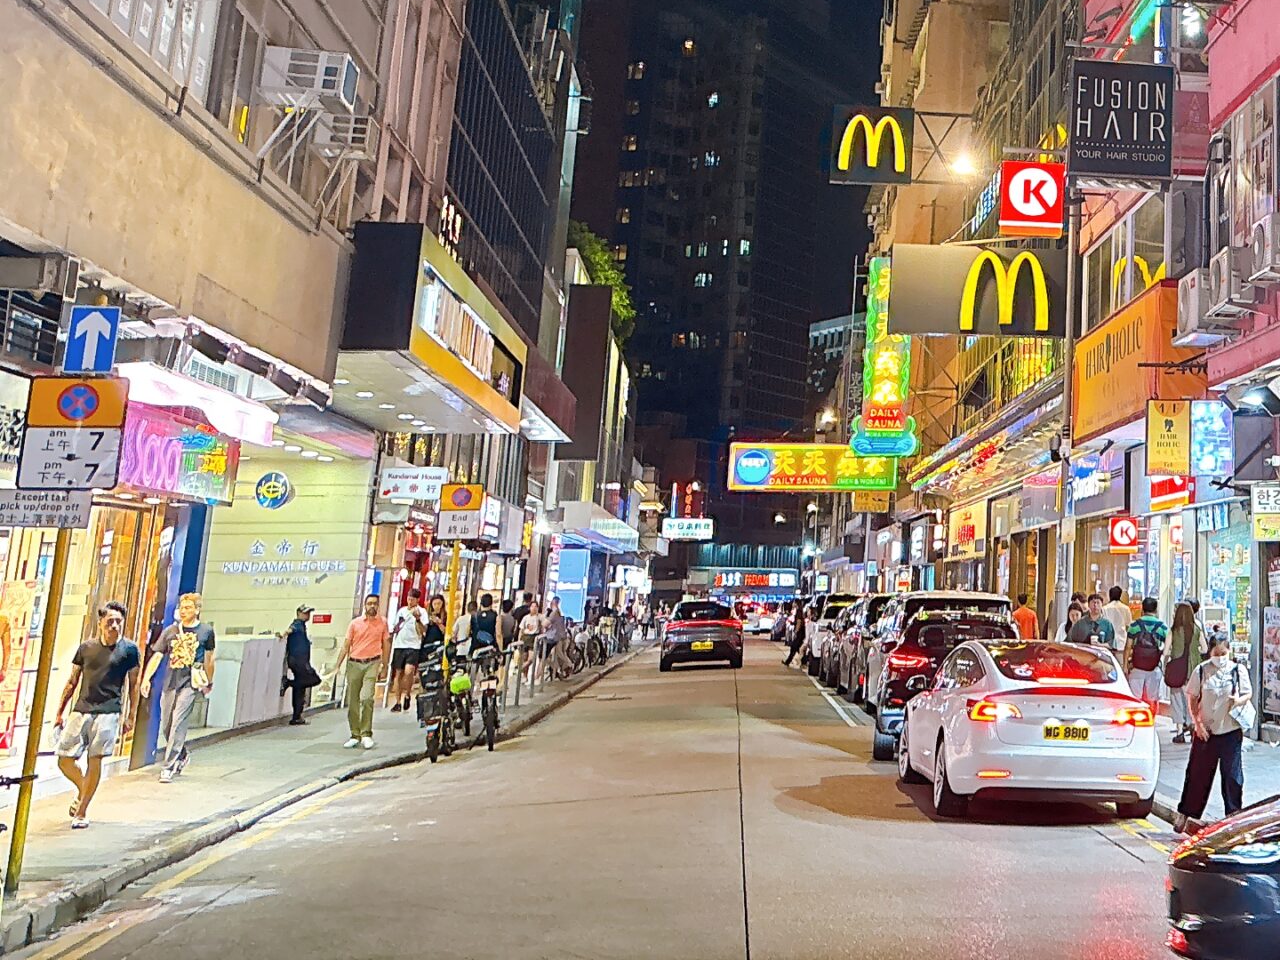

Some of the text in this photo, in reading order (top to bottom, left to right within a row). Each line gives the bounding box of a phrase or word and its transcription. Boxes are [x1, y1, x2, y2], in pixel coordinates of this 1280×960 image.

[1077, 76, 1166, 111] FUSION
[1076, 107, 1166, 142] HAIR
[1076, 149, 1166, 162] YOUR HAIR STUDIO
[1085, 316, 1143, 381] HAIR HOLIC
[870, 408, 899, 418] DAILY
[867, 419, 901, 428] SAUNA
[41, 439, 71, 451] 上午
[89, 431, 105, 451] 7
[38, 471, 66, 483] 下午
[44, 462, 100, 482] pm 7
[768, 477, 795, 485] DAILY
[796, 477, 828, 485] SAUNA
[15, 492, 69, 502] Except taxi
[0, 502, 80, 512] pick up/drop off
[448, 525, 470, 535] 終止
[300, 559, 346, 573] HOUSE
[1064, 726, 1089, 739] 8810
